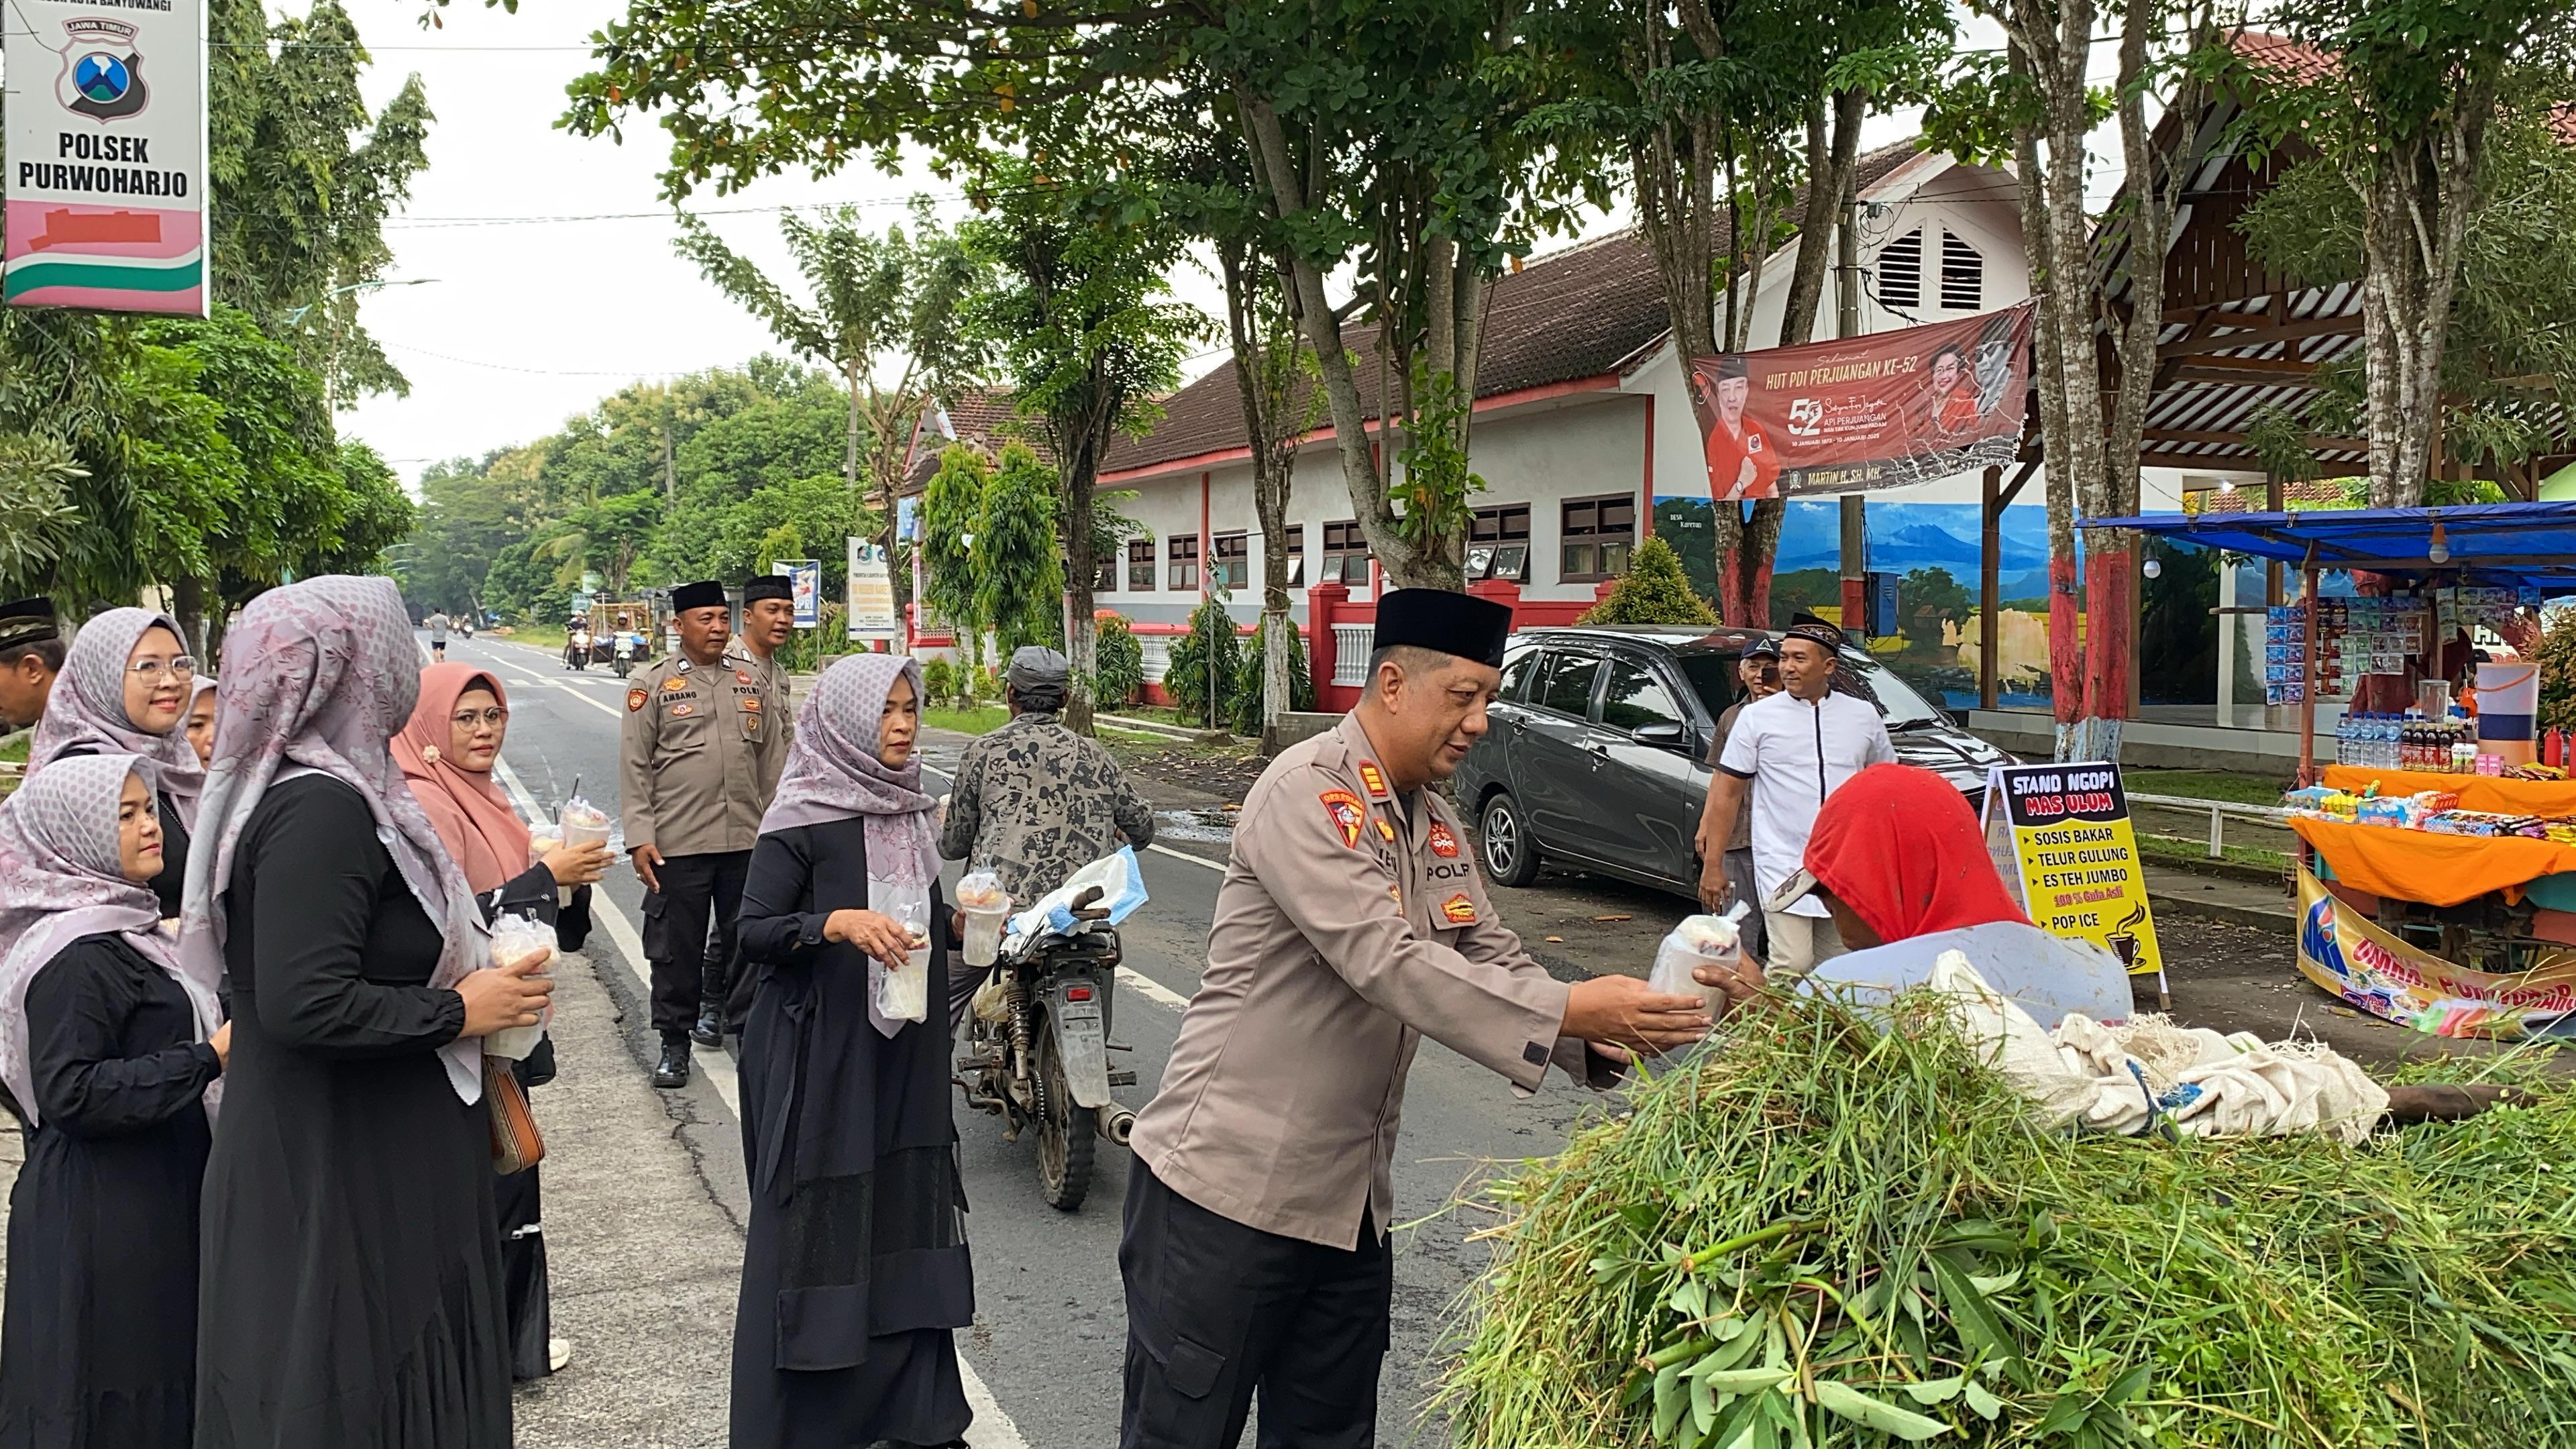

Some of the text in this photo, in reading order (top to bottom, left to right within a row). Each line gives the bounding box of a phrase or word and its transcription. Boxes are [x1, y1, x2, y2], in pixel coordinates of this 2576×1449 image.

[69, 21, 133, 36] JAWA TIMUR
[59, 132, 149, 164] POLSEK
[19, 162, 188, 198] PURWOHARJO
[1814, 349, 1870, 367] Selamat
[1766, 356, 1918, 390] HUT PDI PERJUANGAN KE-52
[1787, 398, 1823, 437] 52
[1824, 413, 1887, 427] API PERJUANGAN
[1808, 471, 1839, 486] MARTIN
[663, 691, 697, 702] AMBANG
[733, 687, 760, 695] POLRI
[2013, 771, 2114, 795] STAND NGOPI
[1323, 793, 1340, 802] OPS
[2025, 792, 2114, 816] MAS ULUM
[2035, 828, 2114, 846] SOSIS BAKAR
[2038, 847, 2129, 867] TELUR GULUNG
[2043, 868, 2128, 888] ES TEH JUMBO
[2053, 885, 2125, 908] 100 % Gula Asli
[2051, 913, 2100, 930] POP ICE
